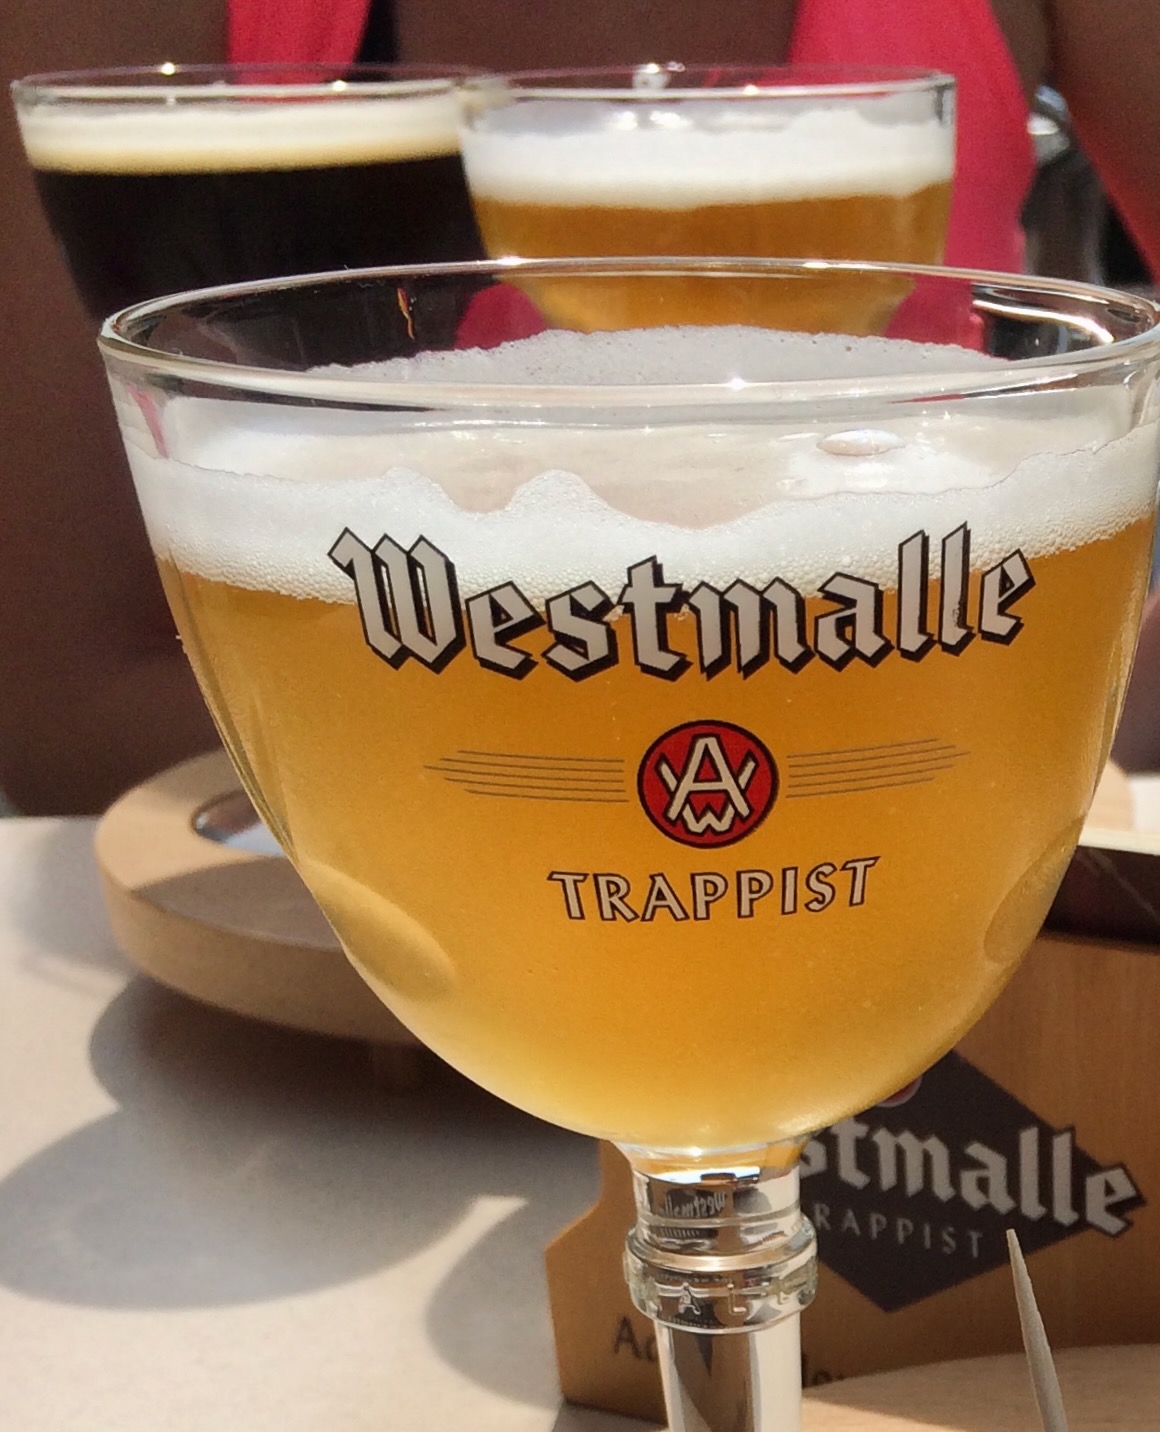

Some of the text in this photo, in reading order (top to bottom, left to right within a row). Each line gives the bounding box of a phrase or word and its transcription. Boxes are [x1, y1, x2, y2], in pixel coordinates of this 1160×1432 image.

[327, 522, 1037, 681] Westmalle
[547, 856, 881, 923] TRAPPIST
[800, 1116, 1146, 1238] stmalle
[813, 1202, 985, 1259] RAPPIST
